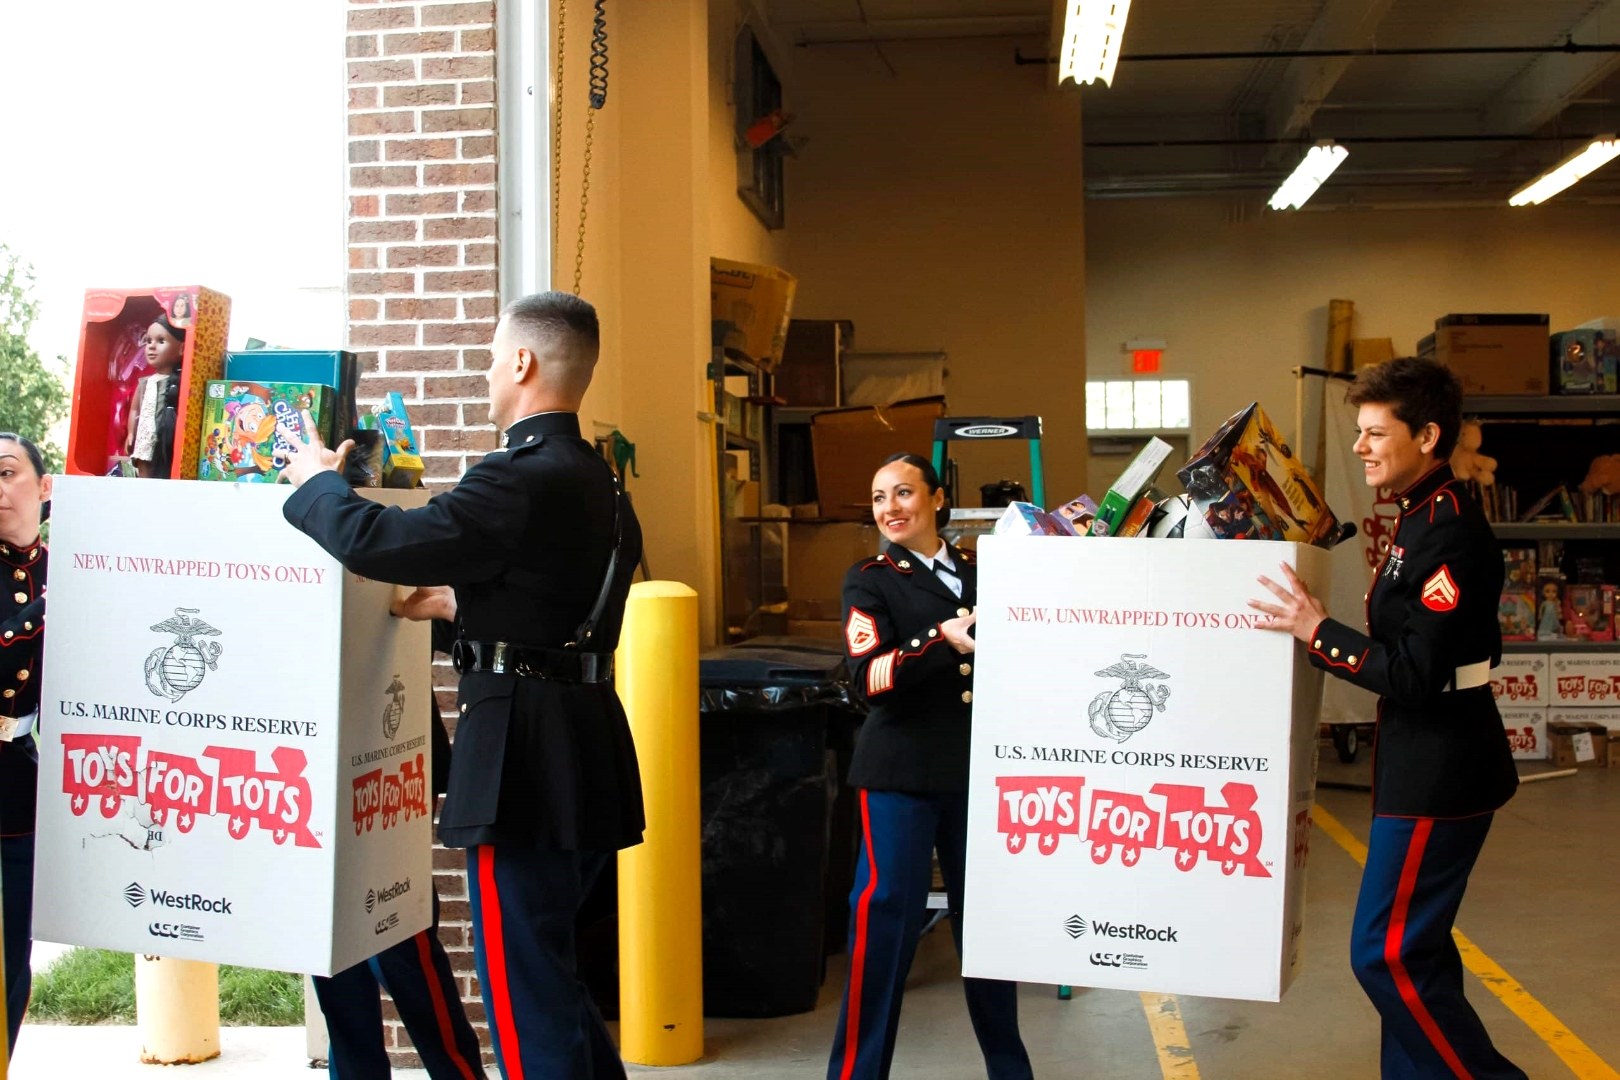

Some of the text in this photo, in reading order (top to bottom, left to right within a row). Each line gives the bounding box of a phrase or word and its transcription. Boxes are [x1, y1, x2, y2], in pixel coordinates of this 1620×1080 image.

[73, 553, 325, 584] NEW, UNWRAPPED TOYS ONLY
[1007, 606, 1051, 625] NEW,
[1056, 608, 1168, 627] UNWRAPPED
[1172, 611, 1220, 629] TOYS
[1508, 682, 1535, 695] TOTS
[1559, 678, 1584, 691] TOYS
[1590, 681, 1609, 692] FOR
[59, 700, 318, 737] U.S. MARINE CORPS RESERVE
[364, 747, 389, 765] MARINE
[389, 741, 406, 757] CORPS
[406, 735, 426, 751] RESERVE
[994, 745, 1269, 772] U.S. MARINE CORPS RESERVE
[68, 745, 300, 824] TOYS FOR TOTS
[355, 777, 423, 813] TOYS FOR TOTS
[1003, 785, 1075, 827] TOYS
[1091, 799, 1151, 842] FOR
[1170, 810, 1250, 856] TOTS
[150, 888, 232, 914] WestRock
[377, 876, 411, 904] WestRock
[1092, 920, 1178, 943] WestRock
